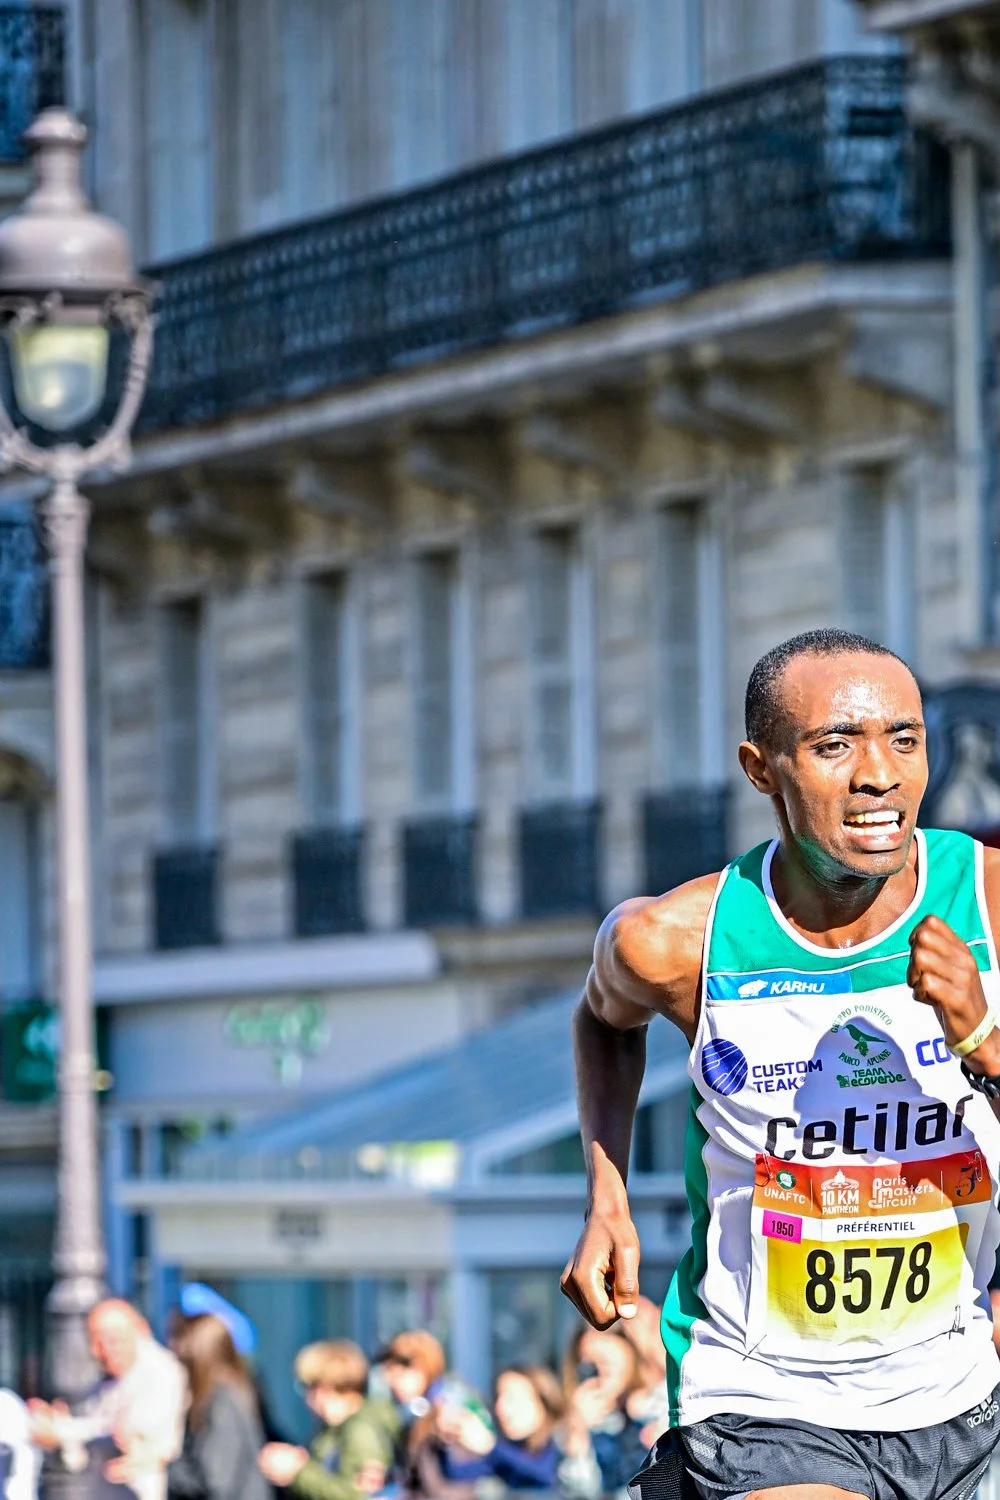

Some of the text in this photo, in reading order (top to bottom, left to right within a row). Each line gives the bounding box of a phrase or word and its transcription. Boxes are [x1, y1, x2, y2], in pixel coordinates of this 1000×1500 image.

[770, 980, 826, 995] KARHU
[854, 1005, 893, 1026] PODISTICO
[838, 1049, 892, 1067] PARCO APUANE
[752, 1059, 823, 1078] CUSTOM
[853, 1067, 887, 1079] TEAM
[764, 1094, 974, 1161] cetilar
[764, 1187, 806, 1204] UNAFTC
[821, 1189, 860, 1206] 10 KM
[836, 1220, 916, 1233] PRÉFÉRENTIEL
[805, 1241, 933, 1314] 8578
[966, 1401, 999, 1428] adidas
